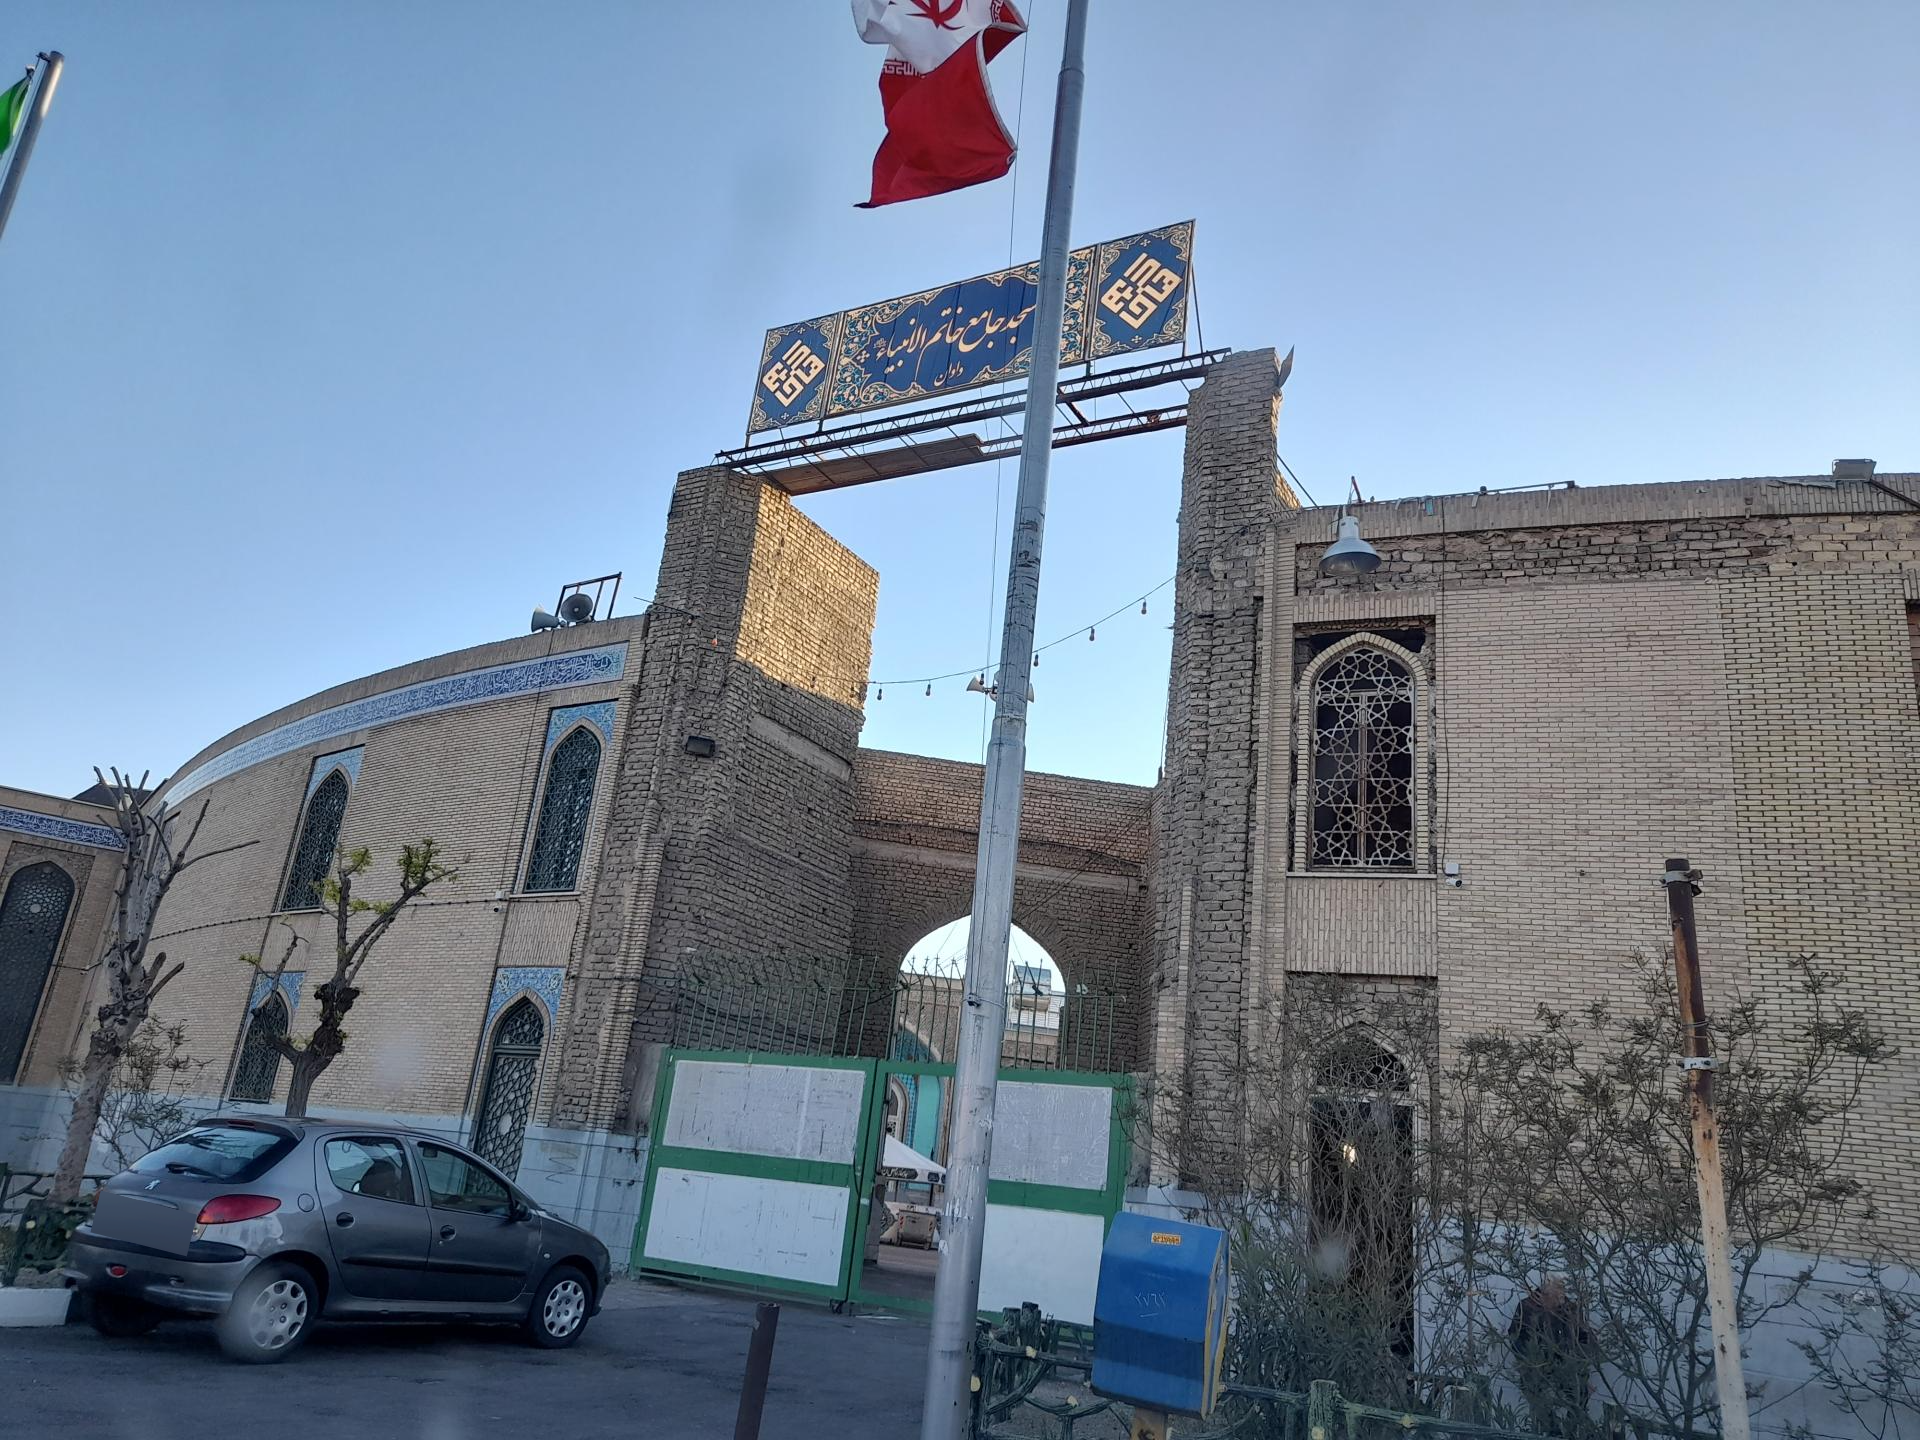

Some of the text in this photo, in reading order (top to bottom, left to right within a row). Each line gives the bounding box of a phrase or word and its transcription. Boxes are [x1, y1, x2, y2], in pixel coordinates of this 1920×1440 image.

[914, 306, 967, 381] خاتم
[958, 308, 1006, 353] جامع
[1000, 303, 1038, 345] سجد
[933, 360, 964, 387] واوان
